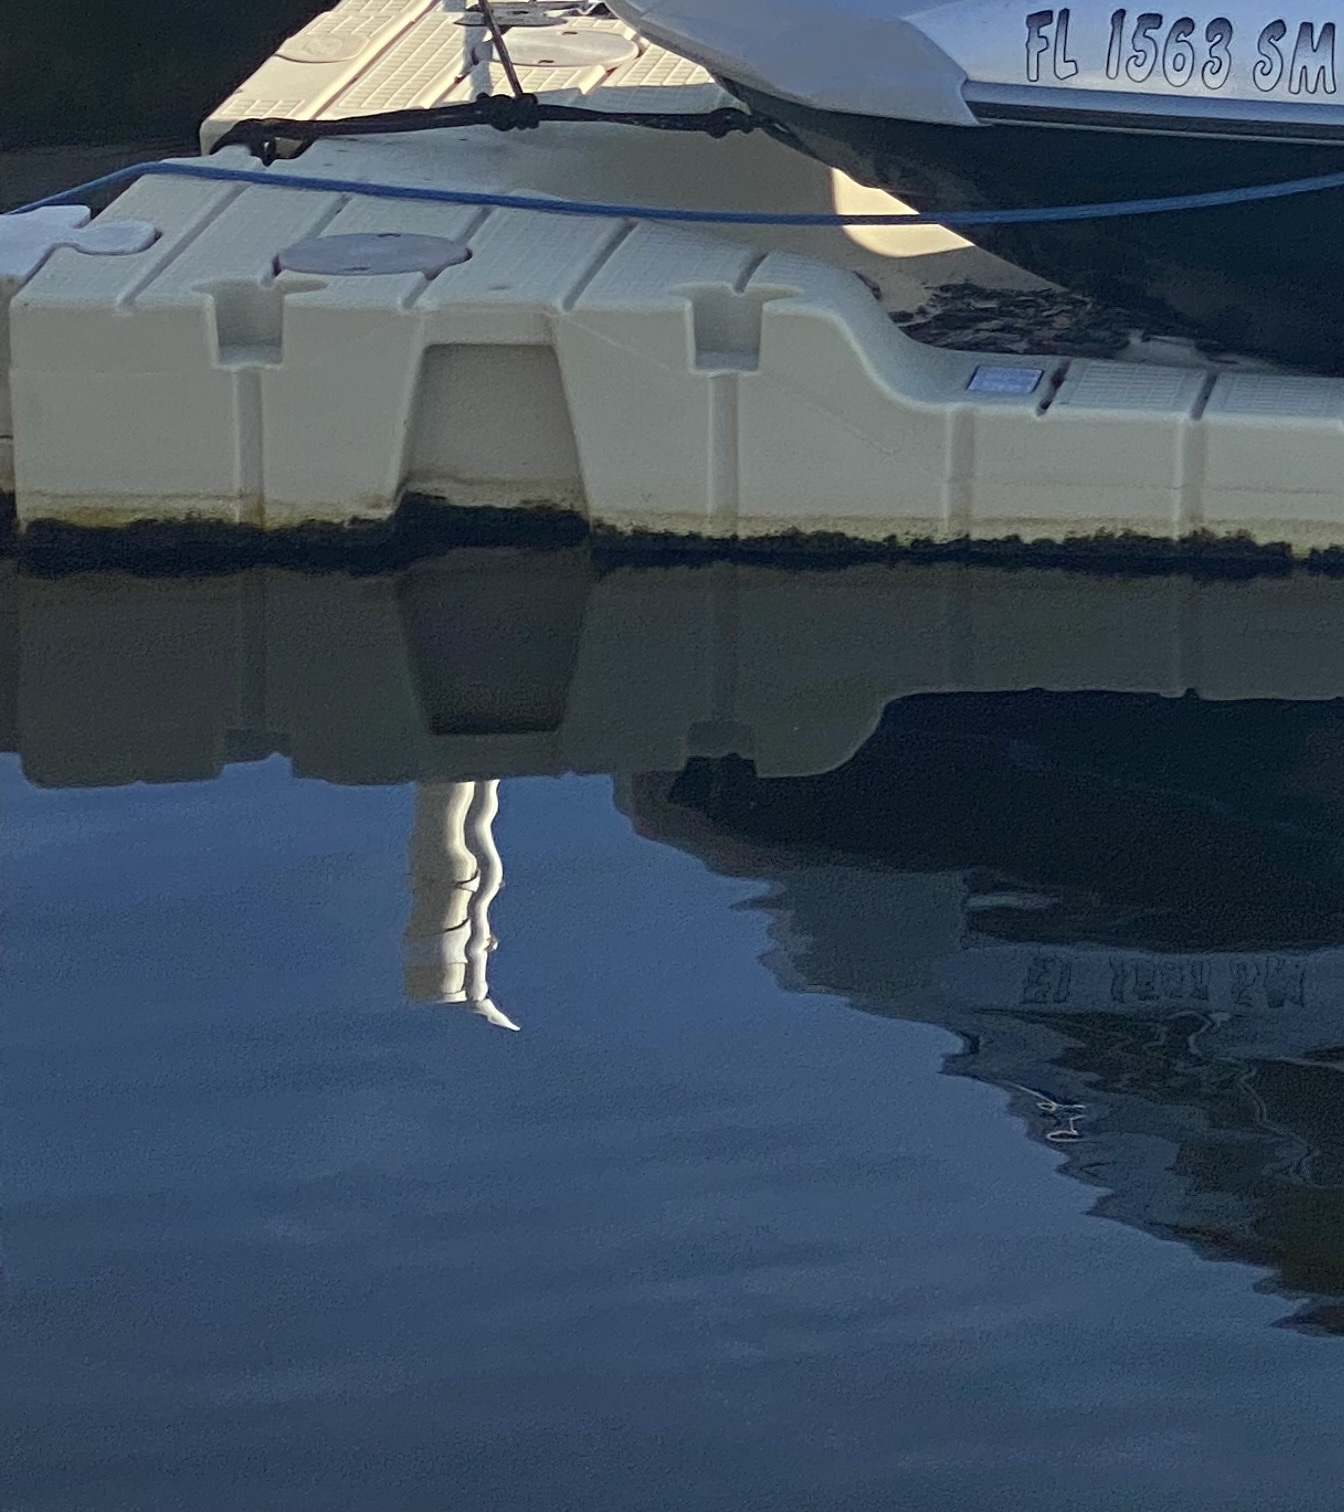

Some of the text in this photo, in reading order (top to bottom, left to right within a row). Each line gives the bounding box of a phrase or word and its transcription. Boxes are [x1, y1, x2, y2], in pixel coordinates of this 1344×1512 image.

[1025, 8, 1336, 95] FL 1563 SM
